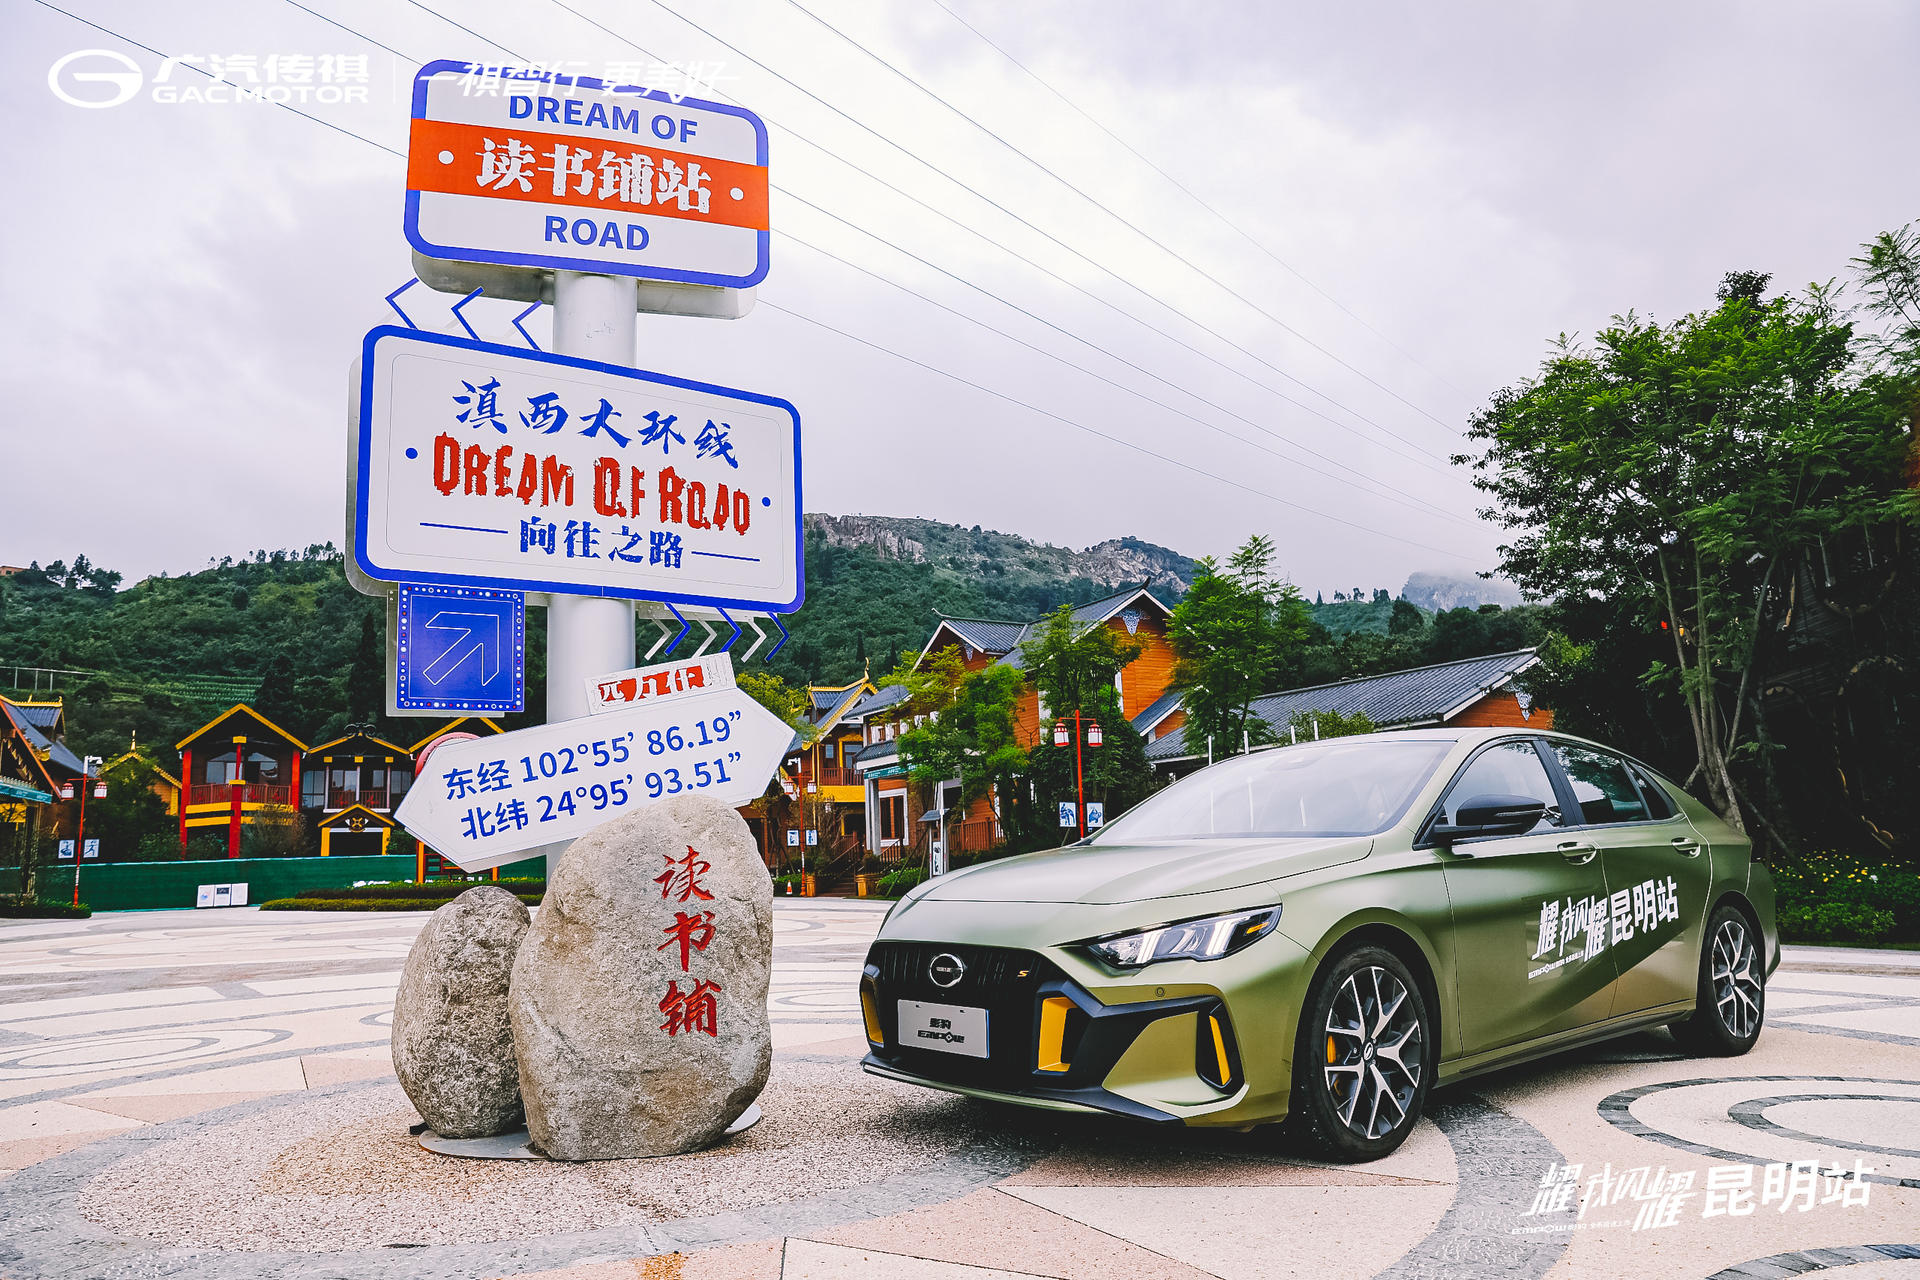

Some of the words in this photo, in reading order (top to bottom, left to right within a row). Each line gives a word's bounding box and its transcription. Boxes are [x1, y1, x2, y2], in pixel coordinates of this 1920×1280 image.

[509, 95, 640, 135] DREAM
[650, 114, 698, 143] OF
[476, 137, 712, 214] 读书铺站
[544, 215, 650, 251] ROAD
[452, 375, 739, 470] 滇西大环线
[433, 431, 575, 508] DREAM
[657, 465, 751, 537] ROAD
[519, 516, 684, 570] 向往之路
[443, 759, 513, 800] 东经
[460, 799, 529, 840] 北纬
[653, 845, 723, 1037] 读书铺
